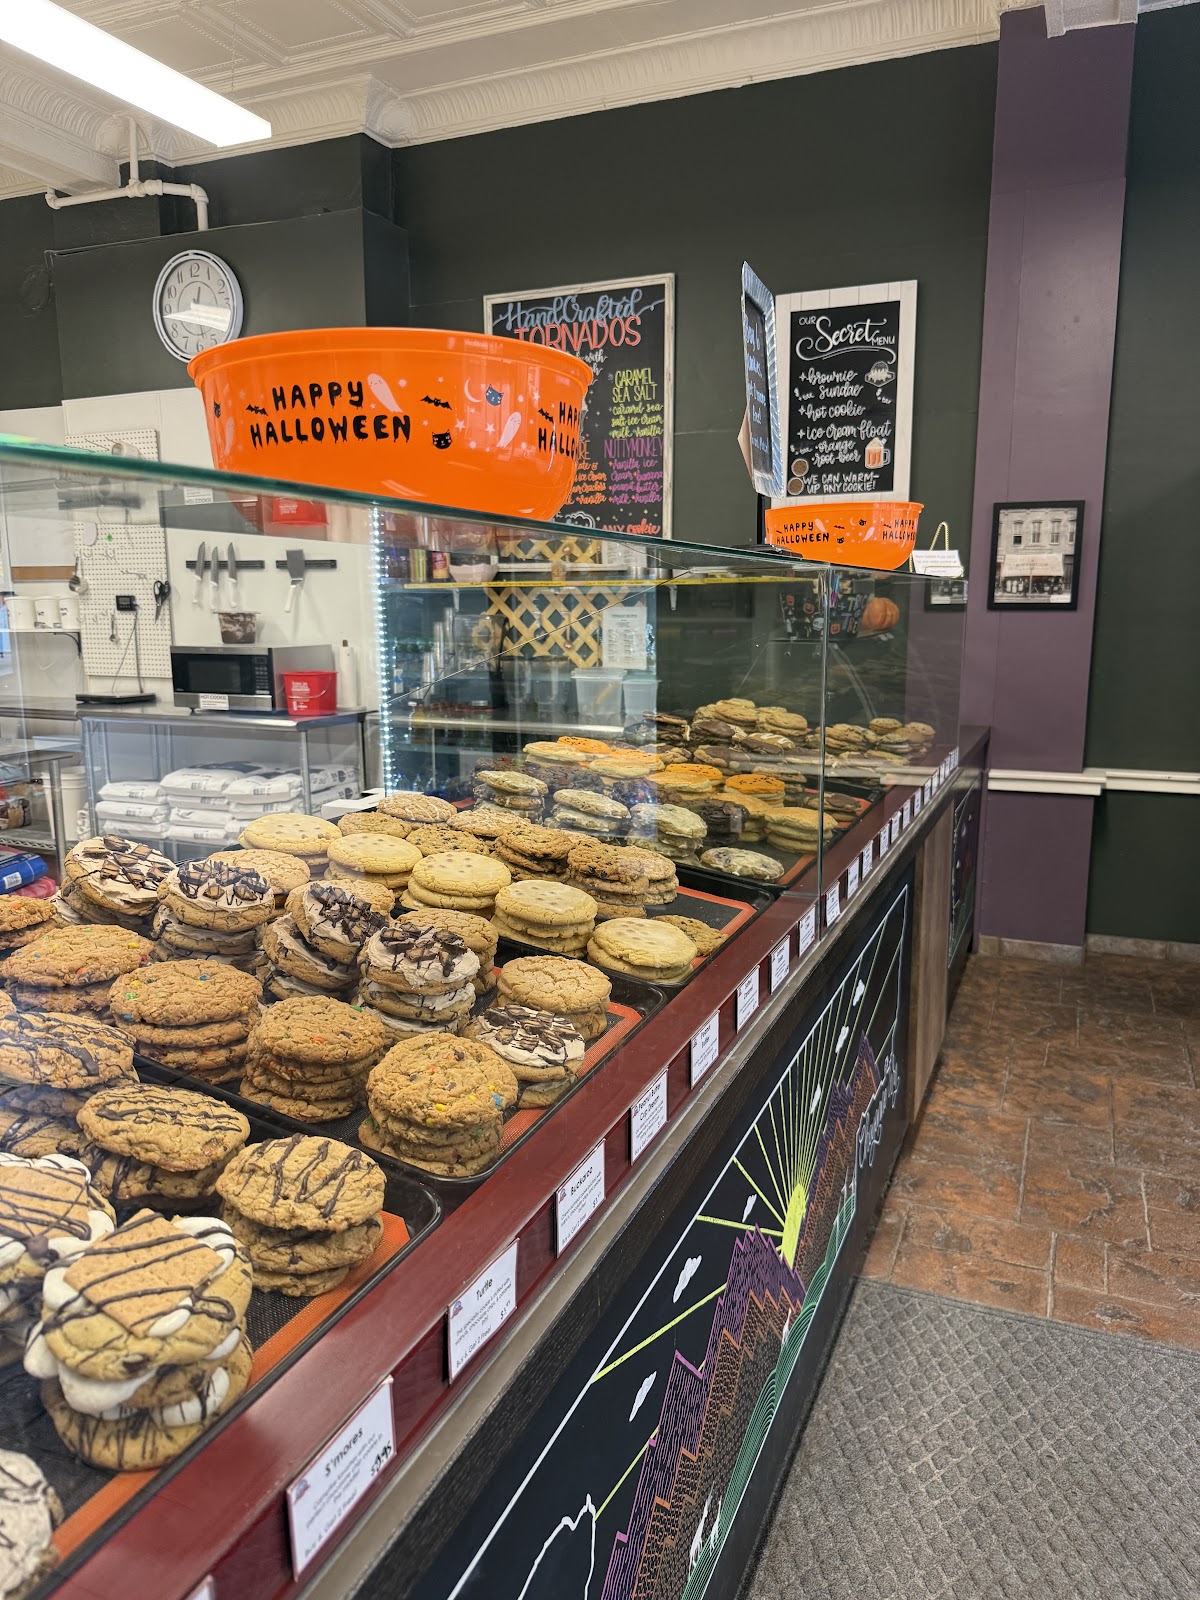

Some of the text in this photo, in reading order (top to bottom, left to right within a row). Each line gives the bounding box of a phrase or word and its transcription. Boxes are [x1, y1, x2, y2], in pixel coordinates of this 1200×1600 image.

[177, 270, 183, 284] 11
[190, 262, 200, 278] 12
[167, 284, 177, 299] 10
[217, 279, 225, 294] 2
[171, 323, 179, 338] 8
[514, 315, 642, 352] TORNADOS
[799, 316, 896, 352] OUR Secret MENU
[182, 336, 189, 350] 7
[615, 367, 655, 388] CARAMEL
[807, 367, 858, 385] brownie
[271, 380, 364, 412] HAPPY
[612, 383, 657, 403] SEA SALT
[805, 399, 866, 421] hot cookie
[249, 414, 411, 450] HALLOWEEN
[806, 426, 825, 440] ice
[858, 419, 892, 441] float
[803, 474, 818, 485] WE
[821, 472, 840, 484] CAN
[806, 480, 876, 494] UP ANY COOKIE!
[783, 521, 814, 533] HAPPY
[776, 532, 830, 545] HALLOWEEN
[571, 1167, 593, 1196] Buckaroo
[476, 1279, 493, 1300] Turtle
[325, 1428, 363, 1477] S'mores
